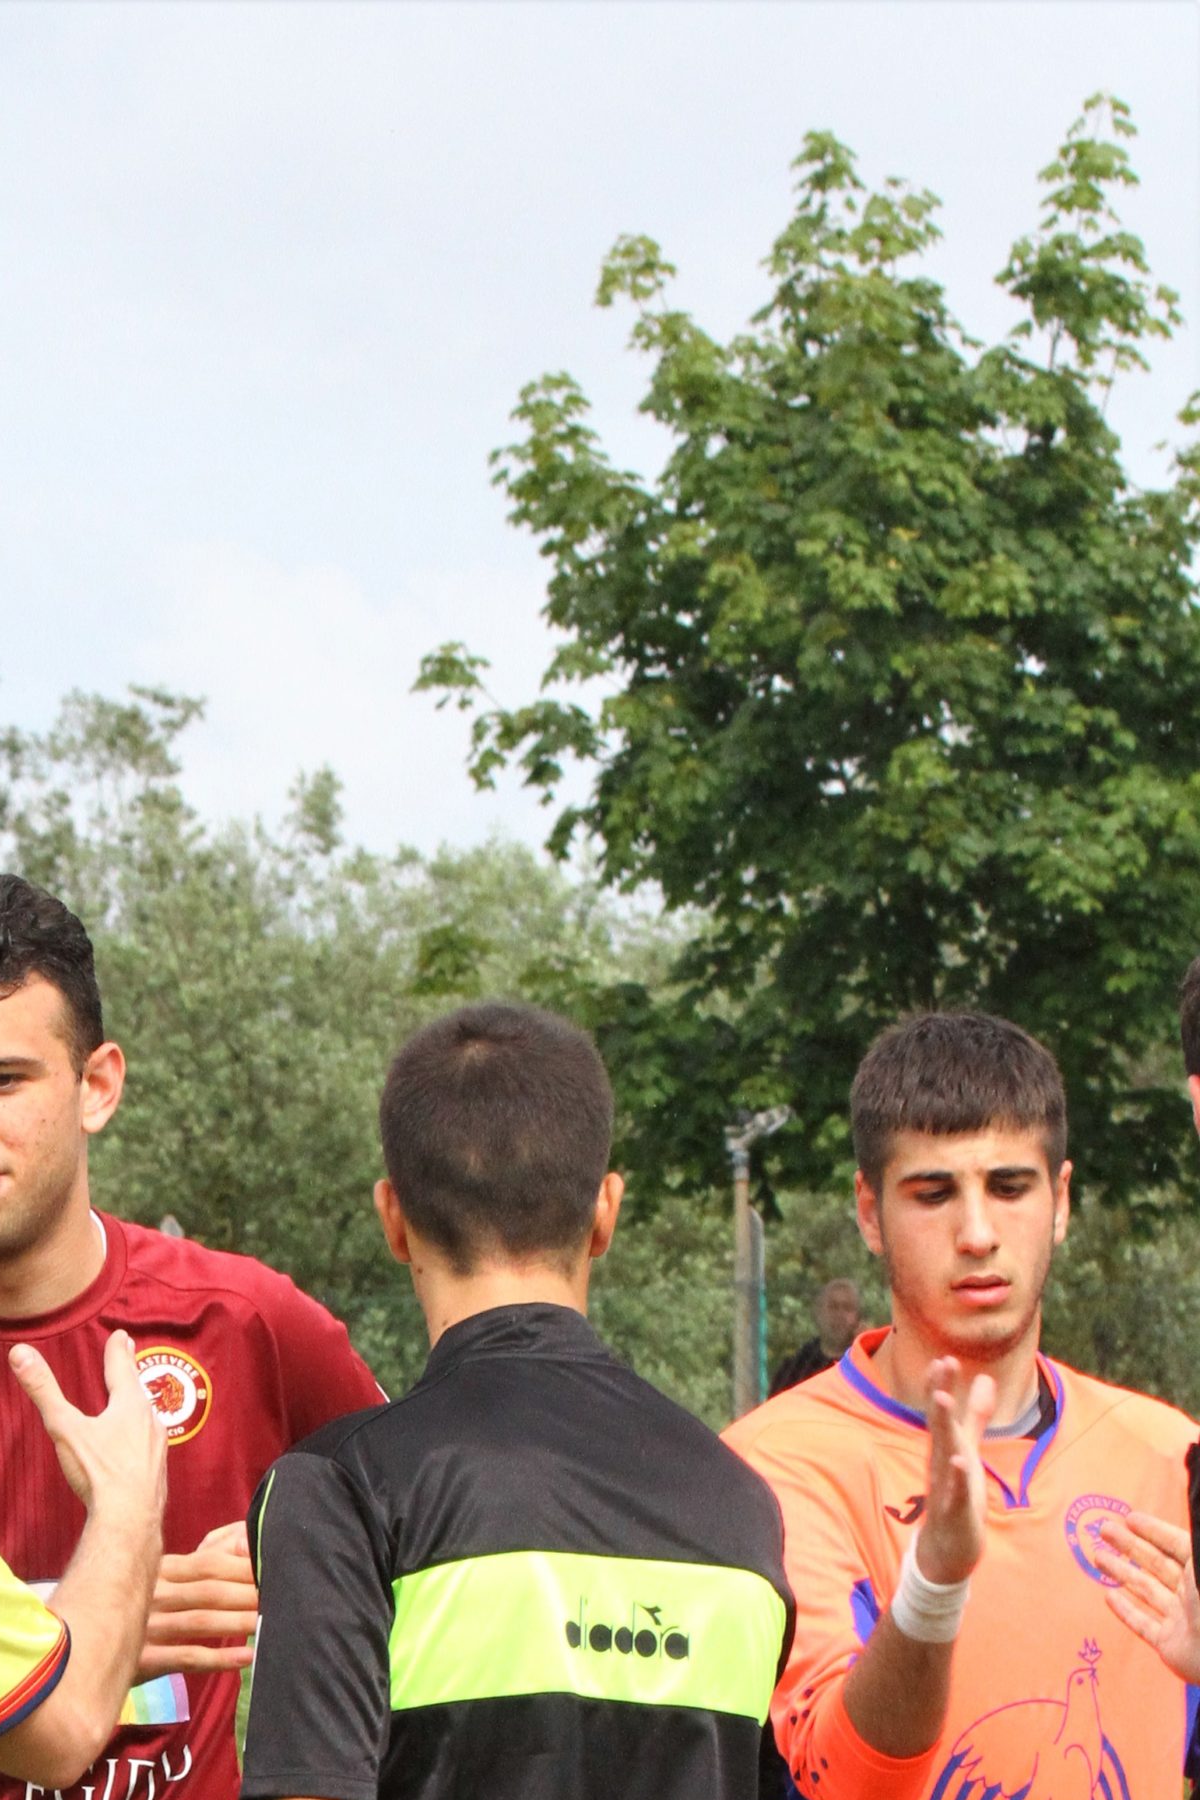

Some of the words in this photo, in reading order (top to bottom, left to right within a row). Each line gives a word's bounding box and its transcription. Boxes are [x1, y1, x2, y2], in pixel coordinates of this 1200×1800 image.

[138, 1354, 200, 1380] ASTEVERE
[1066, 1496, 1132, 1524] TRASTEVER
[565, 1595, 690, 1660] diadora
